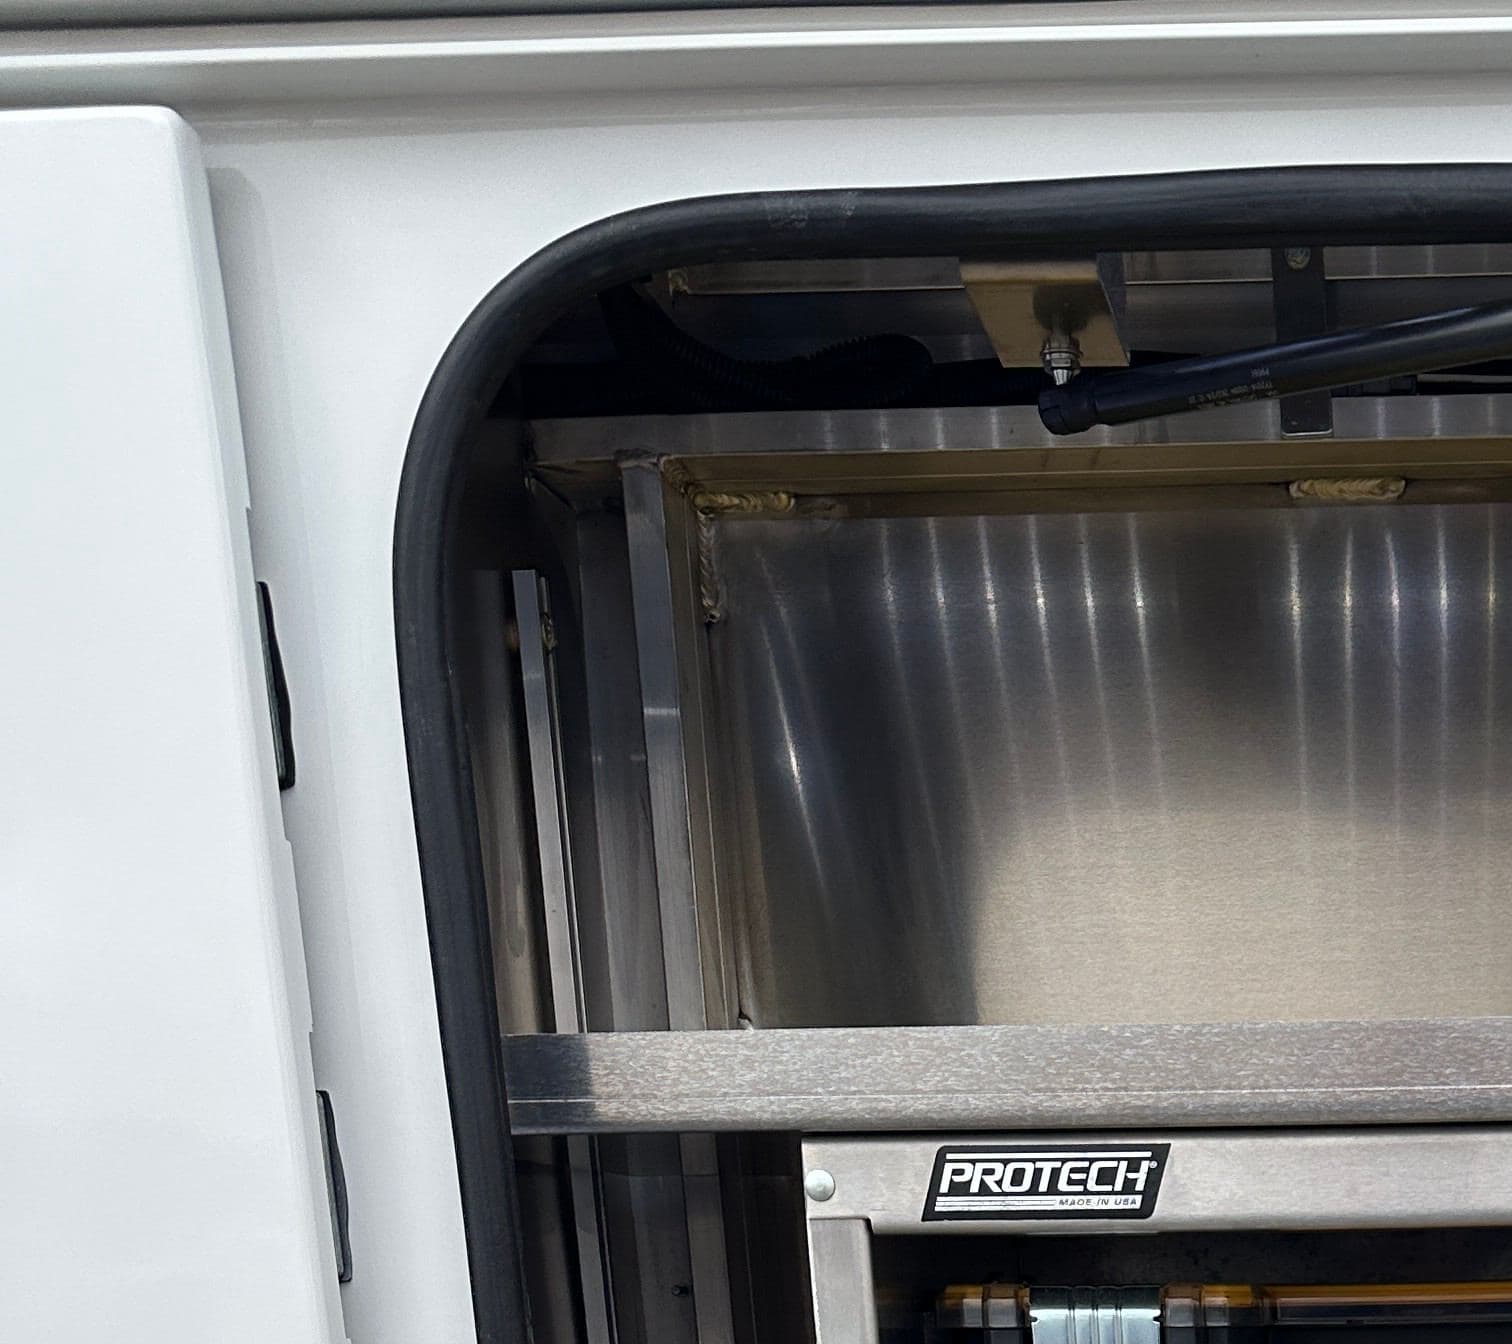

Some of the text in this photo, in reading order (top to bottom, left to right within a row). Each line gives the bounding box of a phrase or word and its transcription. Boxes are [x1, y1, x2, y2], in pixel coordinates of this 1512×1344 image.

[939, 1160, 1150, 1194] PROTECH
[1059, 1197, 1137, 1207] MADE IN USA
